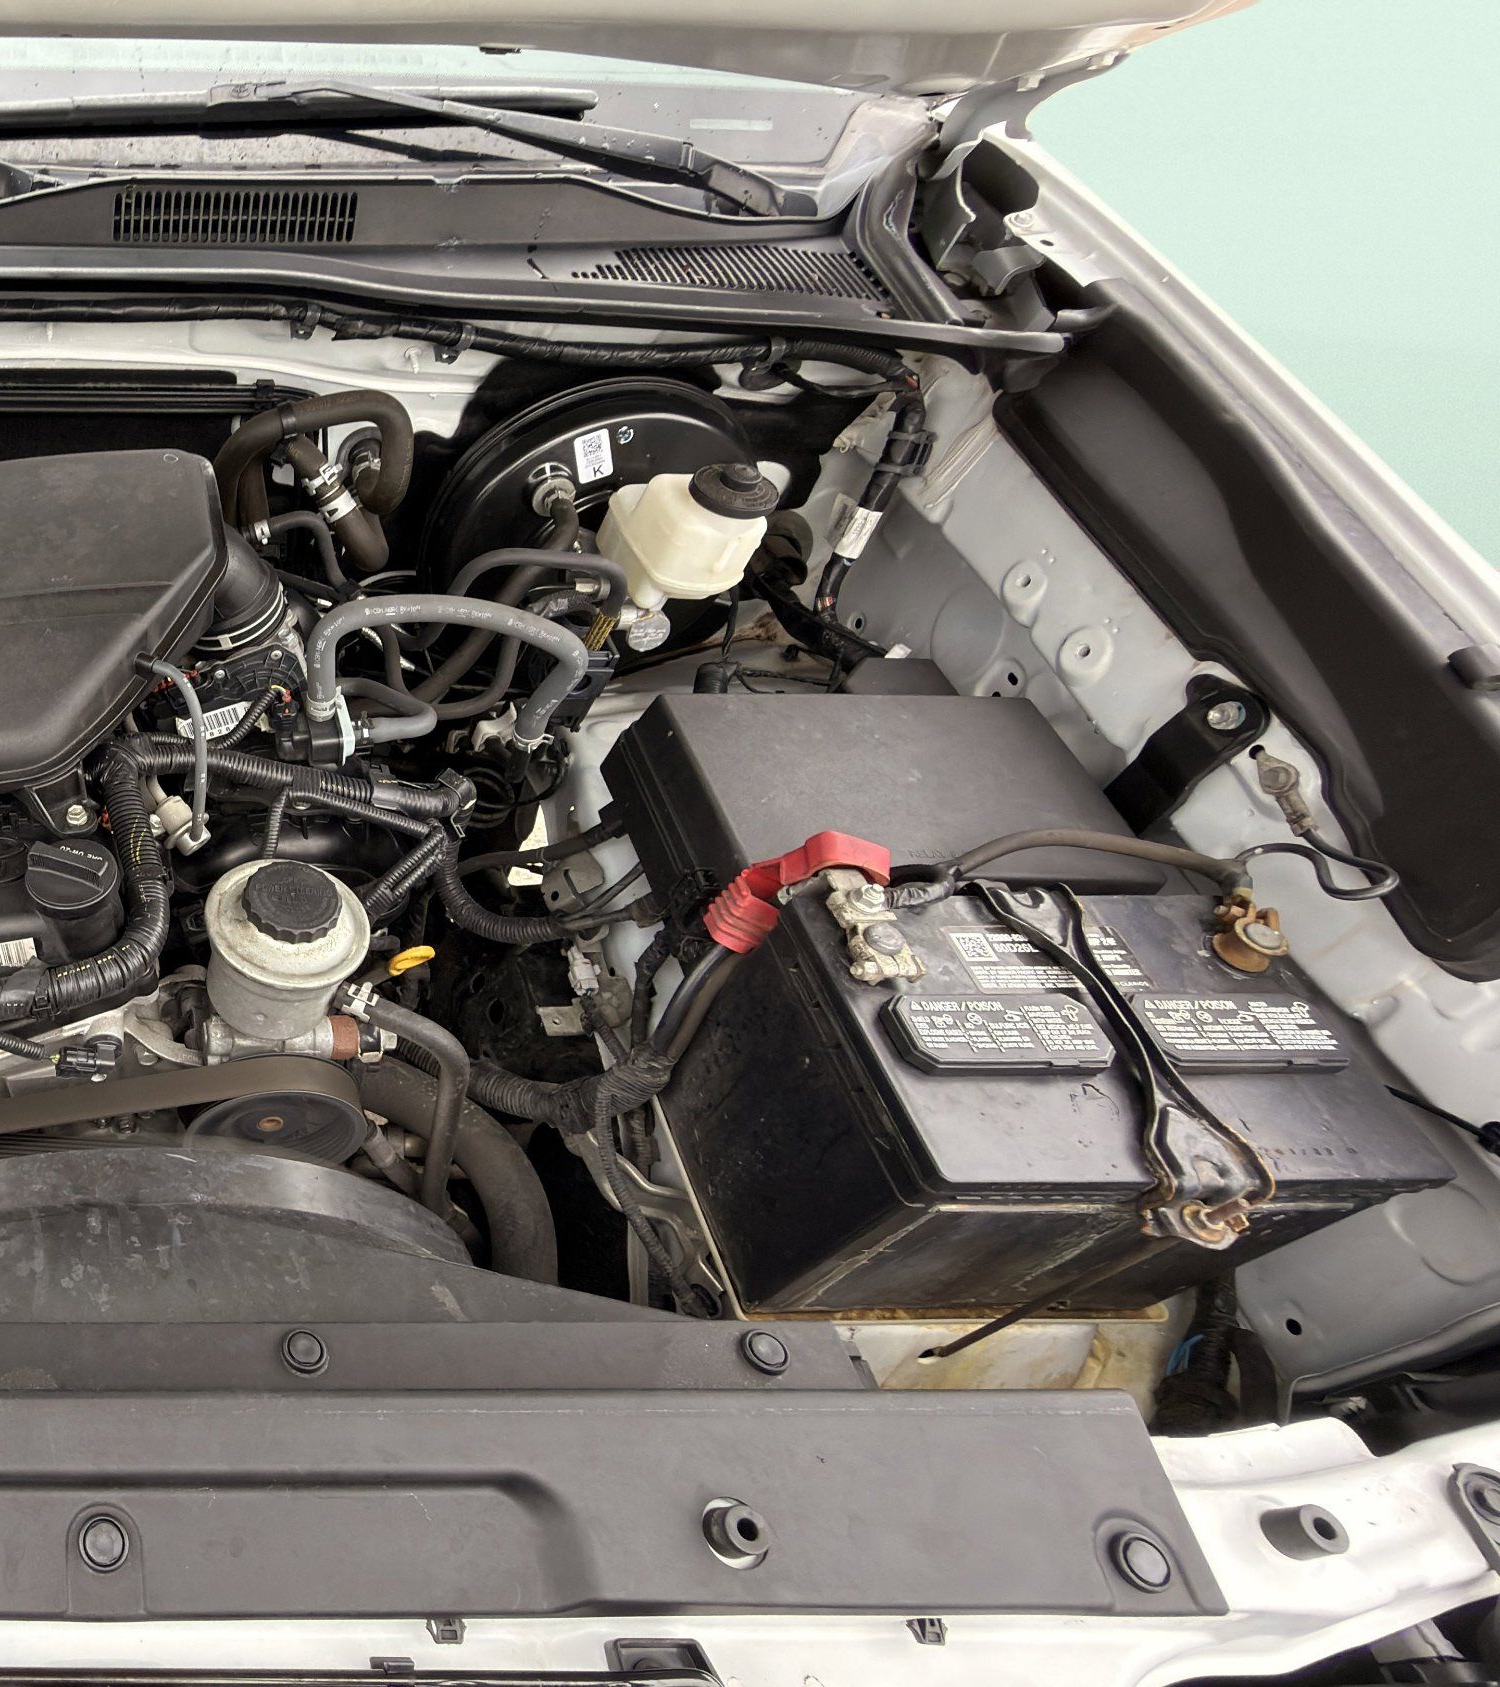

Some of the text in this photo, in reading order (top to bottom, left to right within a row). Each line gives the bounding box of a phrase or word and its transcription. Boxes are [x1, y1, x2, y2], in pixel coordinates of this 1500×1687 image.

[593, 464, 604, 477] K
[920, 1001, 960, 1012] DANGER
[966, 1001, 1005, 1012] POISON
[1154, 1000, 1193, 1011] DANGER
[1202, 1000, 1237, 1010] POISON
